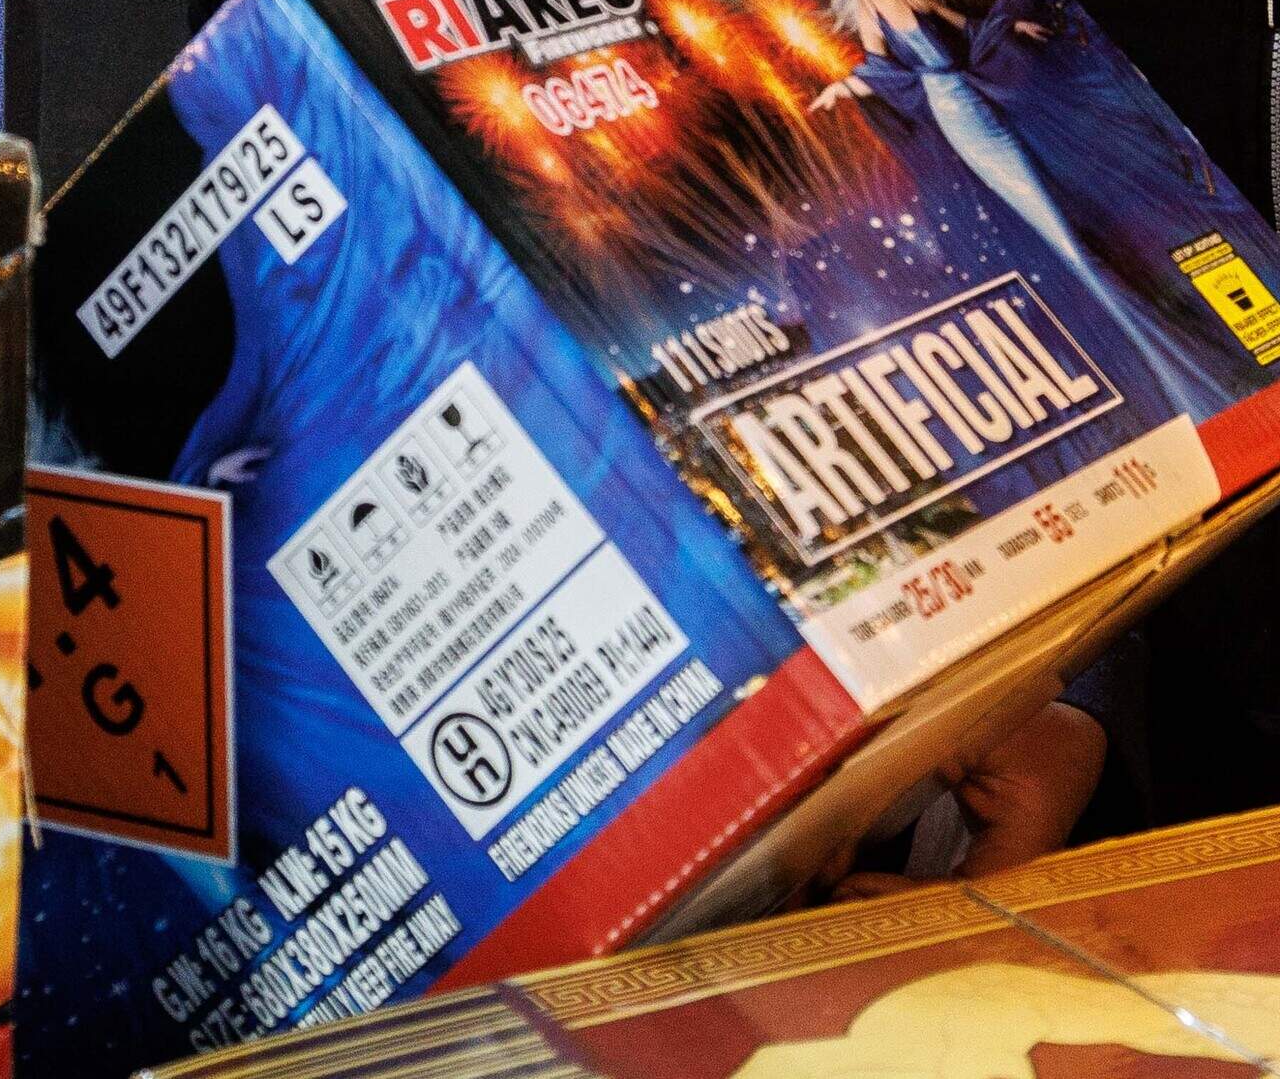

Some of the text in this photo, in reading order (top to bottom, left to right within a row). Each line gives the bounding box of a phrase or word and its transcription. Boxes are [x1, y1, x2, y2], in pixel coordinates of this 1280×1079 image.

[521, 58, 660, 136] 06474
[93, 120, 289, 340] 49F132/179/25
[271, 182, 325, 245] LS
[732, 298, 1100, 541] ARTIFICIAL
[81, 662, 146, 738] G
[152, 749, 191, 795] 1
[487, 789, 580, 884] FIREWORKS
[605, 704, 668, 774] MADE
[657, 656, 725, 725] CHINA
[305, 815, 356, 877] 15
[327, 786, 388, 855] KG
[195, 924, 241, 981] 16
[218, 897, 273, 961] KG
[346, 954, 396, 1015] KEEP
[375, 922, 419, 986] FIRE
[405, 892, 464, 961] AWAY
